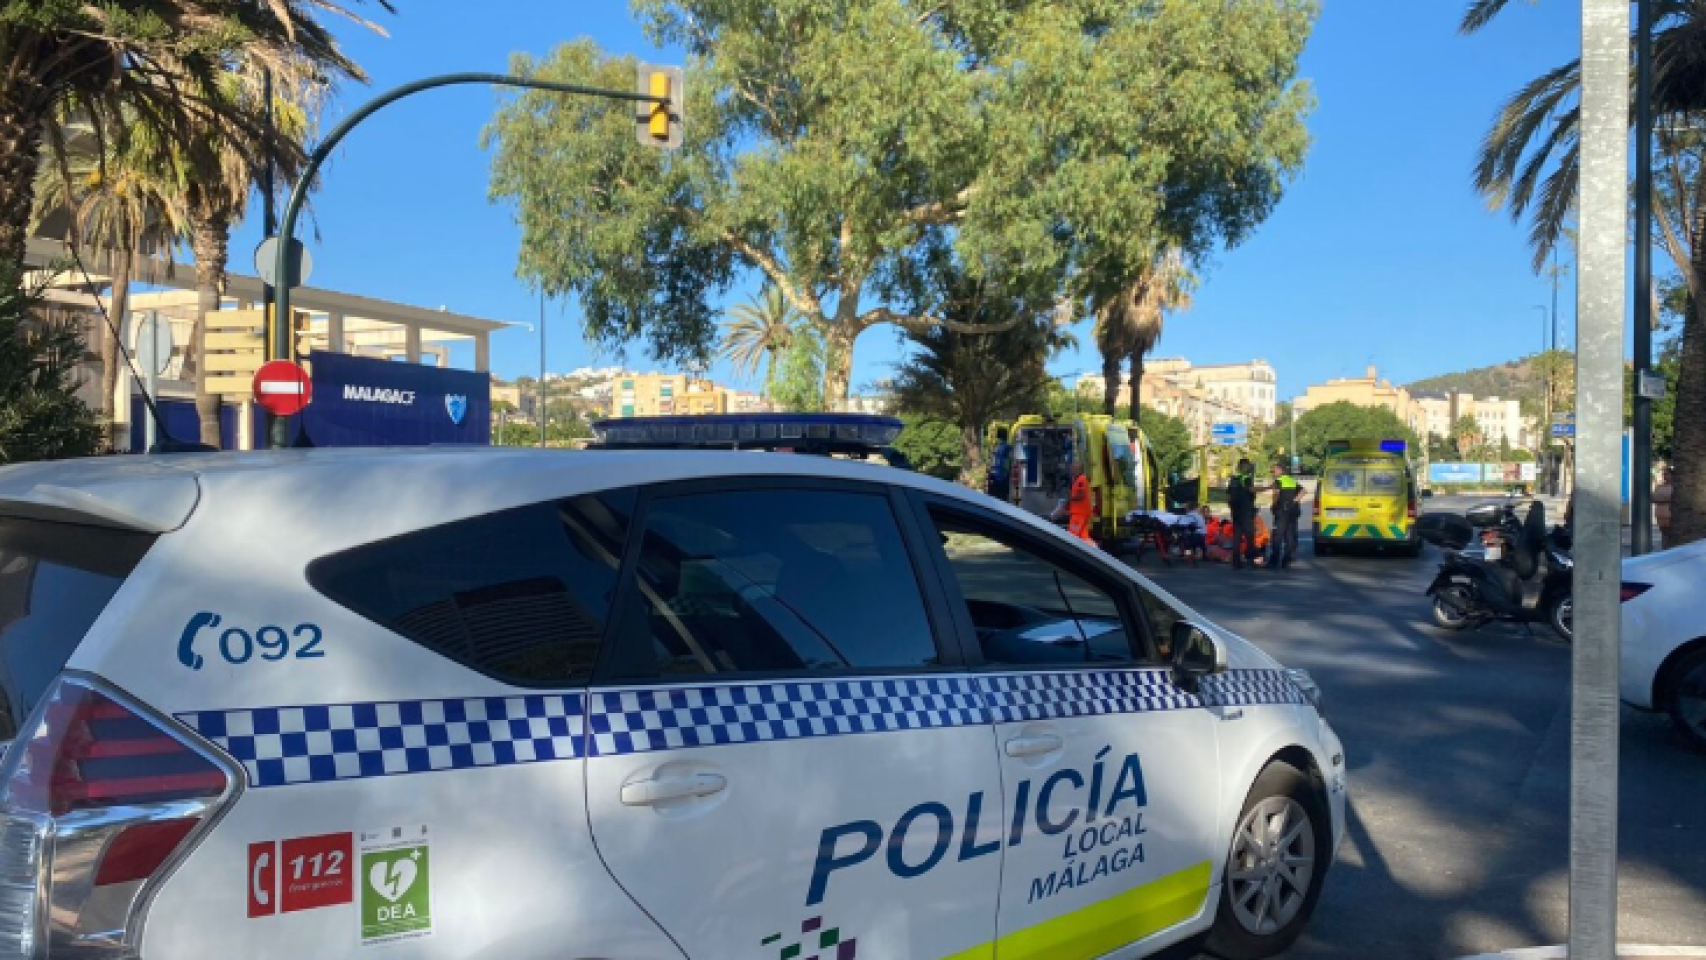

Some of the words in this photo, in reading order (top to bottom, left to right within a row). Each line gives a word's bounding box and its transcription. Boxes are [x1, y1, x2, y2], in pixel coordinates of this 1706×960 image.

[219, 622, 325, 664] 092
[805, 744, 1148, 906] POLICÍA
[1062, 812, 1148, 859] LOCAL
[289, 850, 345, 879] 112
[1028, 842, 1146, 904] MÁLAGA
[377, 902, 416, 921] DEA
